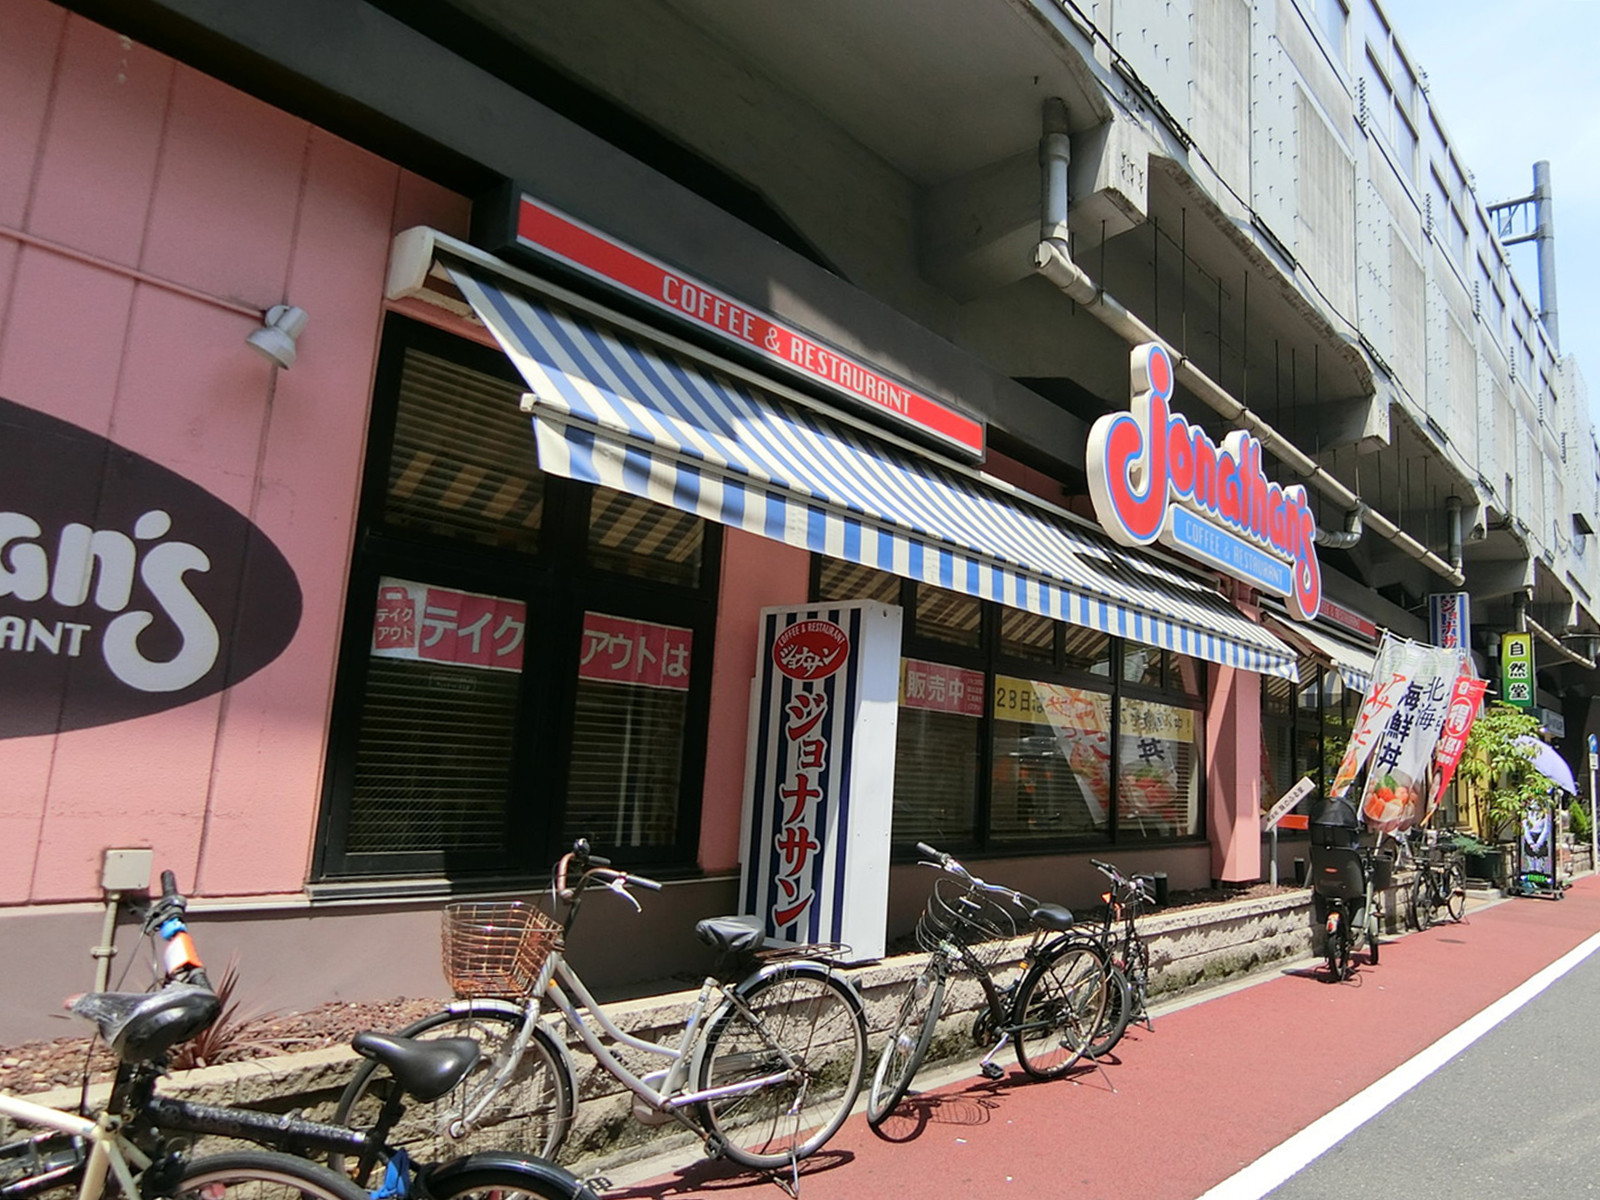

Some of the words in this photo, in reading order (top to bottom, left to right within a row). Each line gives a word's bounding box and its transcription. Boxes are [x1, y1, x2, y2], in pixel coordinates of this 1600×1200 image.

[662, 275, 755, 341] COFFEE
[763, 327, 781, 354] &
[790, 337, 912, 414] RESTAURANT
[1185, 519, 1221, 555] COFFEE
[376, 607, 413, 623] テイク
[377, 625, 413, 641] アウト
[424, 605, 526, 657] テイク
[778, 626, 800, 647] COFFEE
[581, 629, 690, 677] アウトは
[1509, 640, 1530, 701] 自然堂
[905, 670, 965, 706] 販売中
[1376, 680, 1424, 775] 海鮮丼
[774, 692, 828, 928] ジョナサン
